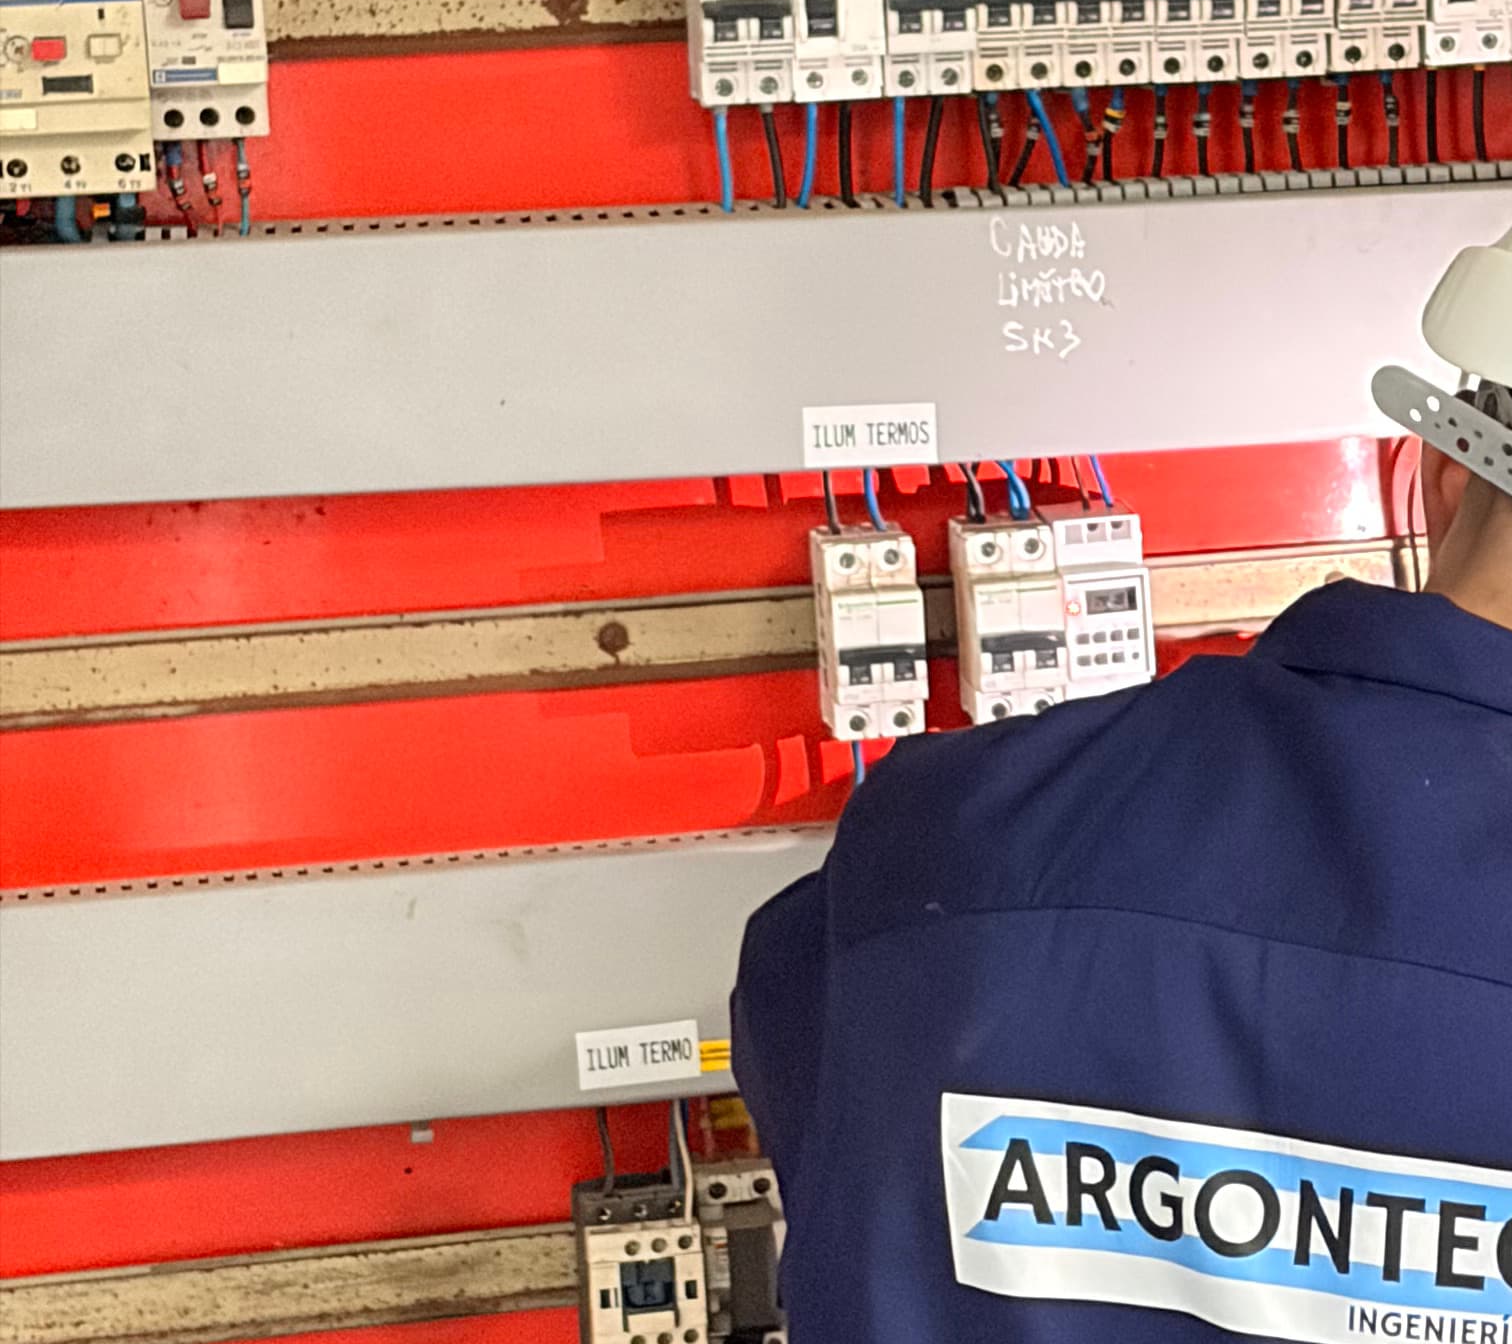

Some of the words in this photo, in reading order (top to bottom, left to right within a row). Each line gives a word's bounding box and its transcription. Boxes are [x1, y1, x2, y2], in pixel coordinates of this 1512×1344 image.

[812, 424, 856, 448] ILUM
[865, 420, 930, 446] TERMOS
[586, 1045, 630, 1071] ILUM
[639, 1037, 693, 1065] TERMO
